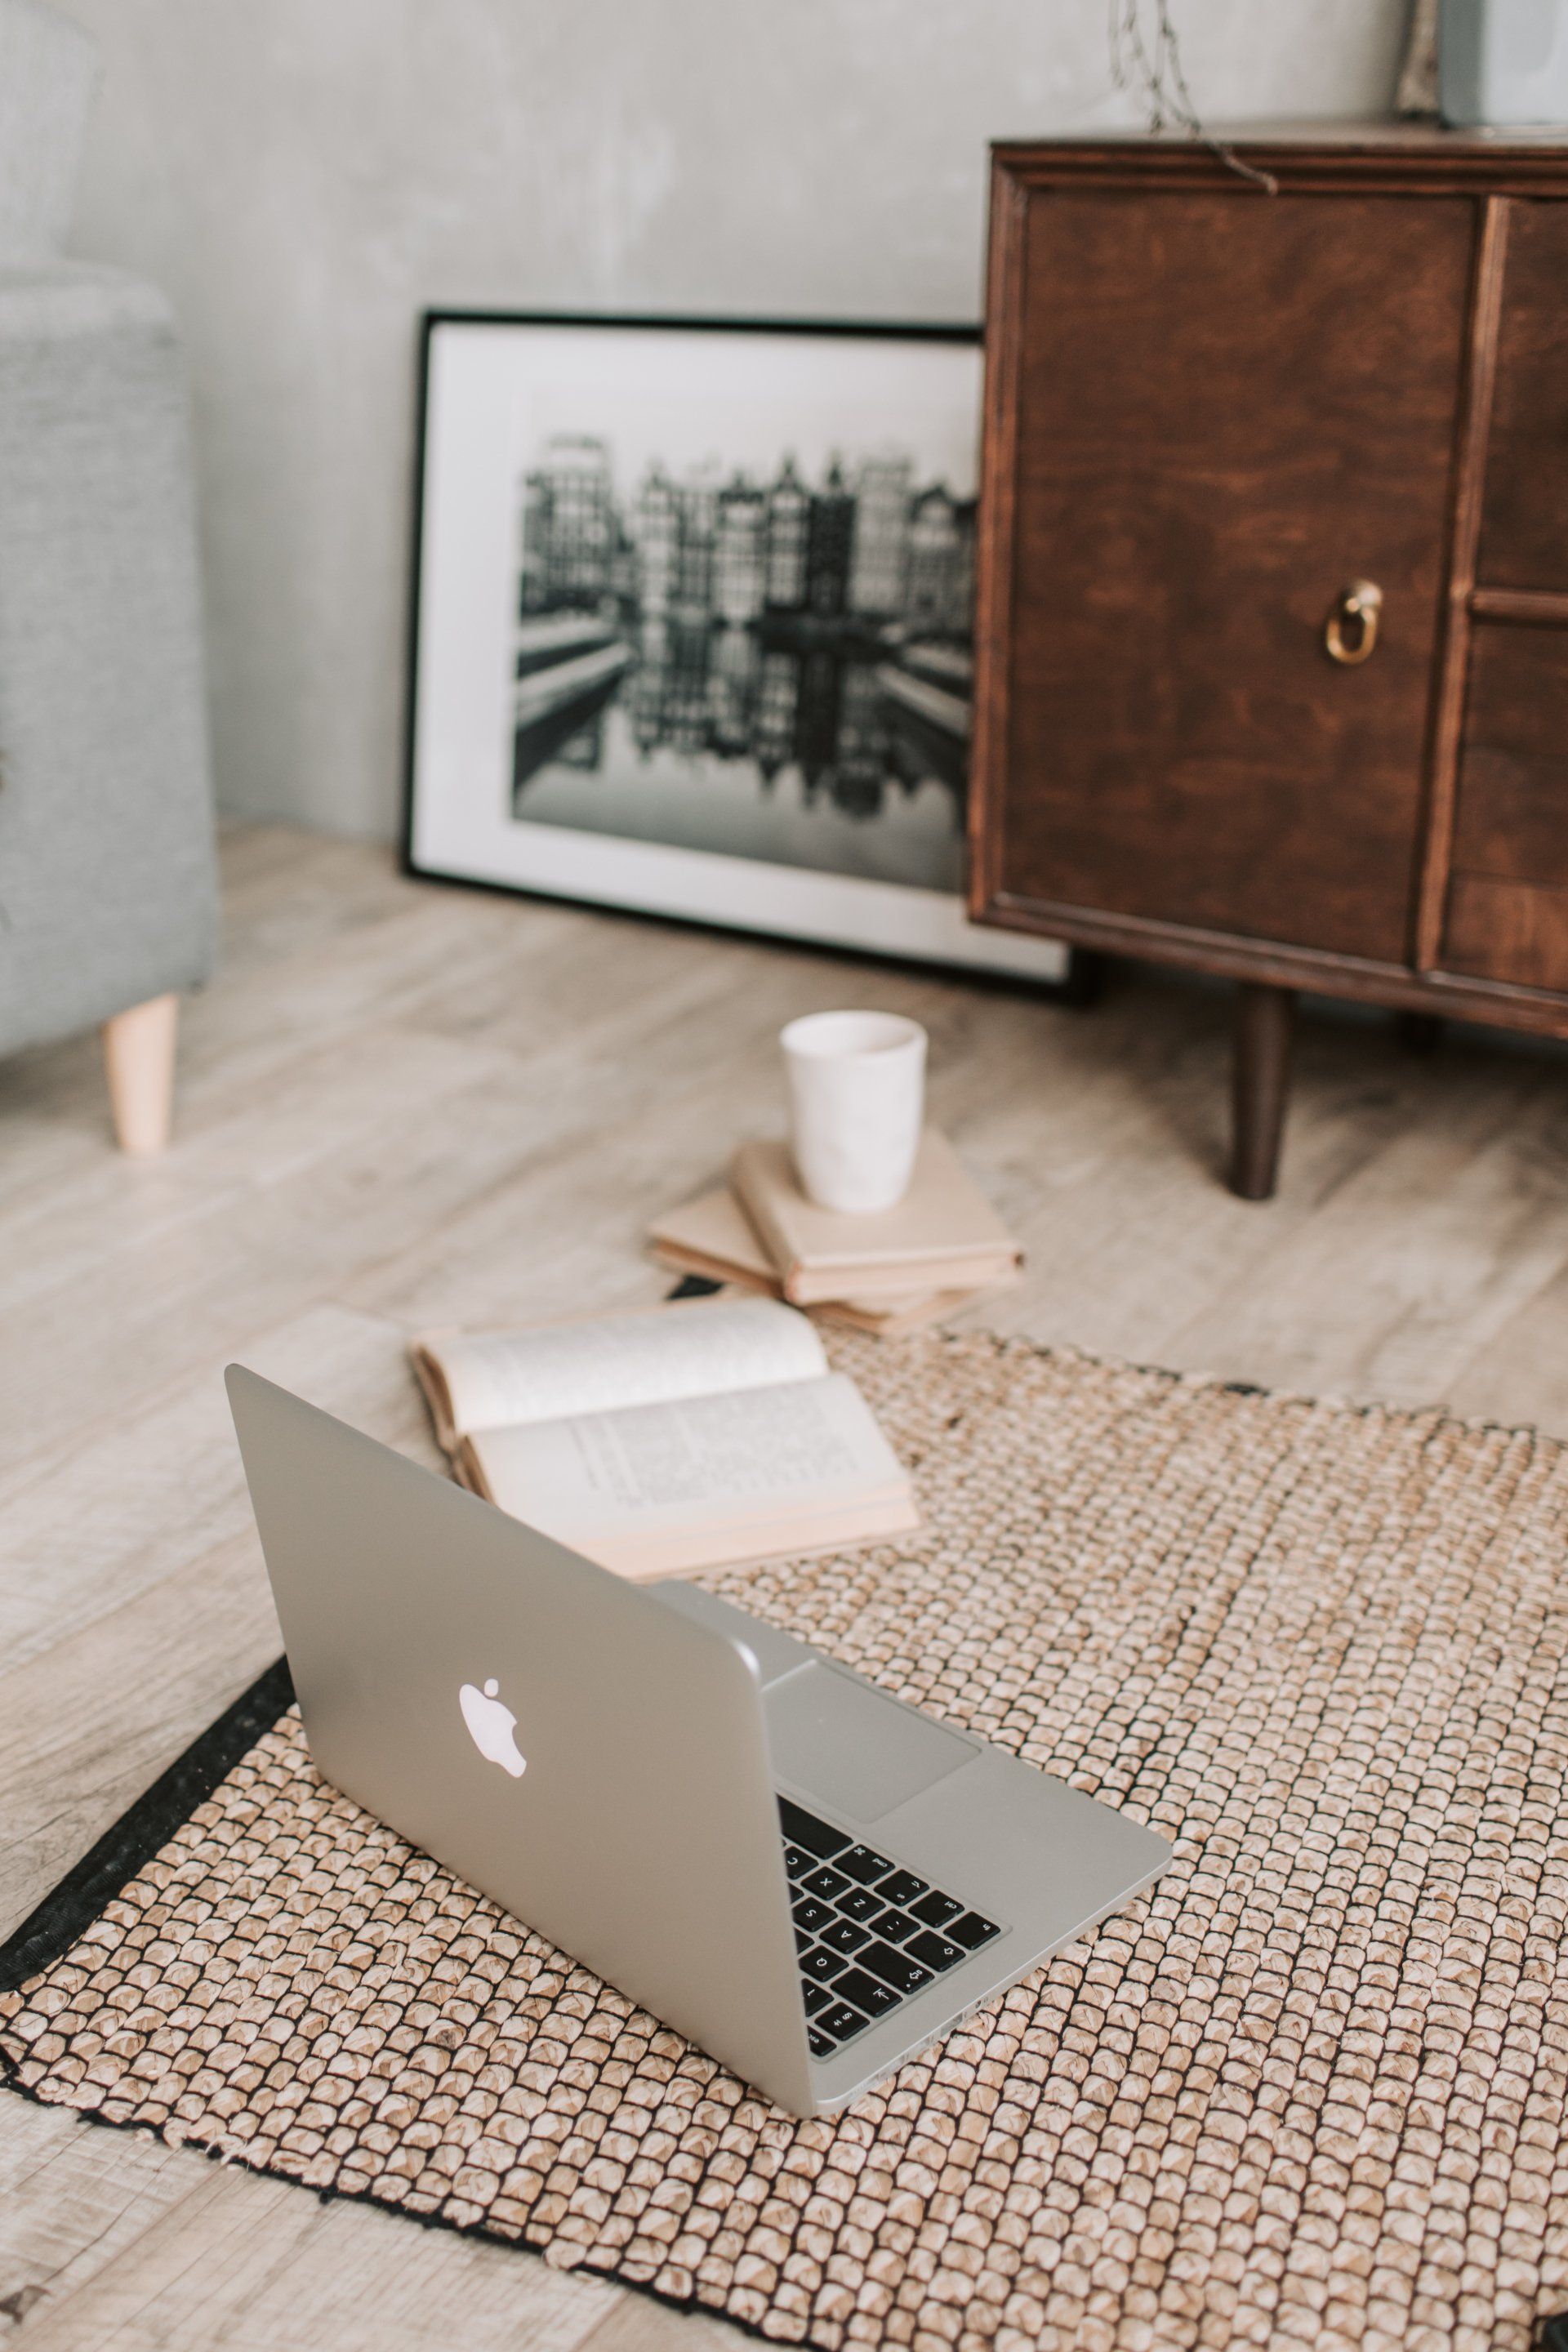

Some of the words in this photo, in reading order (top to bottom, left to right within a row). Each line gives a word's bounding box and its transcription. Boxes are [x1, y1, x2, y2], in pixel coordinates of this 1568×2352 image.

[787, 1857, 799, 1865] C
[871, 1857, 888, 1868] cmd
[820, 1878, 833, 1886] X
[853, 1899, 866, 1908] Z
[944, 1901, 958, 1910] ctrl
[806, 1909, 817, 1918] S
[982, 1923, 991, 1931] fn
[841, 1930, 852, 1938] A
[817, 1956, 827, 1967] Q
[807, 1988, 815, 1996] 1
